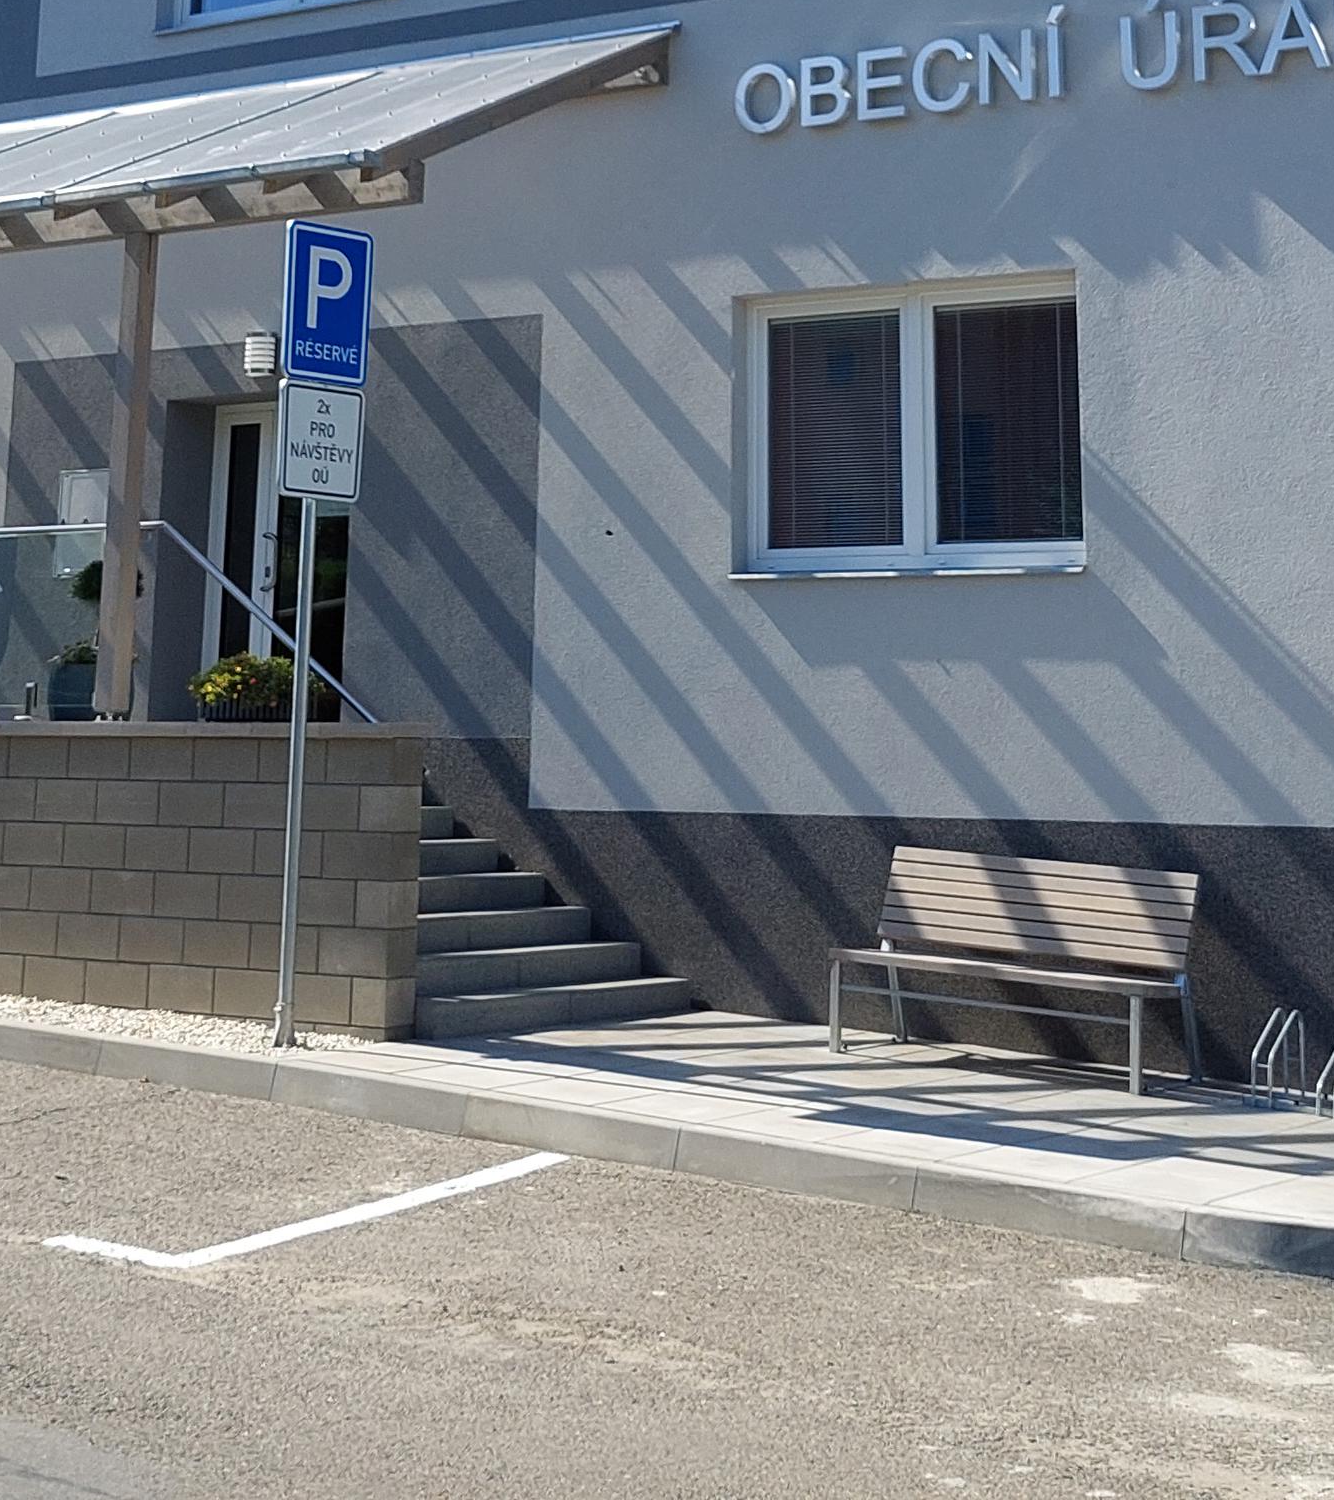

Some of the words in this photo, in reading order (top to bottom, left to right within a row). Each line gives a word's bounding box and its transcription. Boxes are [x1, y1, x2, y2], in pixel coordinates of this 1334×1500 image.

[734, 4, 1066, 134] OBECNÍ
[306, 245, 353, 329] P
[295, 338, 358, 365] RÉSERVÉ
[316, 399, 331, 416] 2x
[309, 420, 336, 439] PRO
[290, 439, 354, 464] NÁVŠTĚVY
